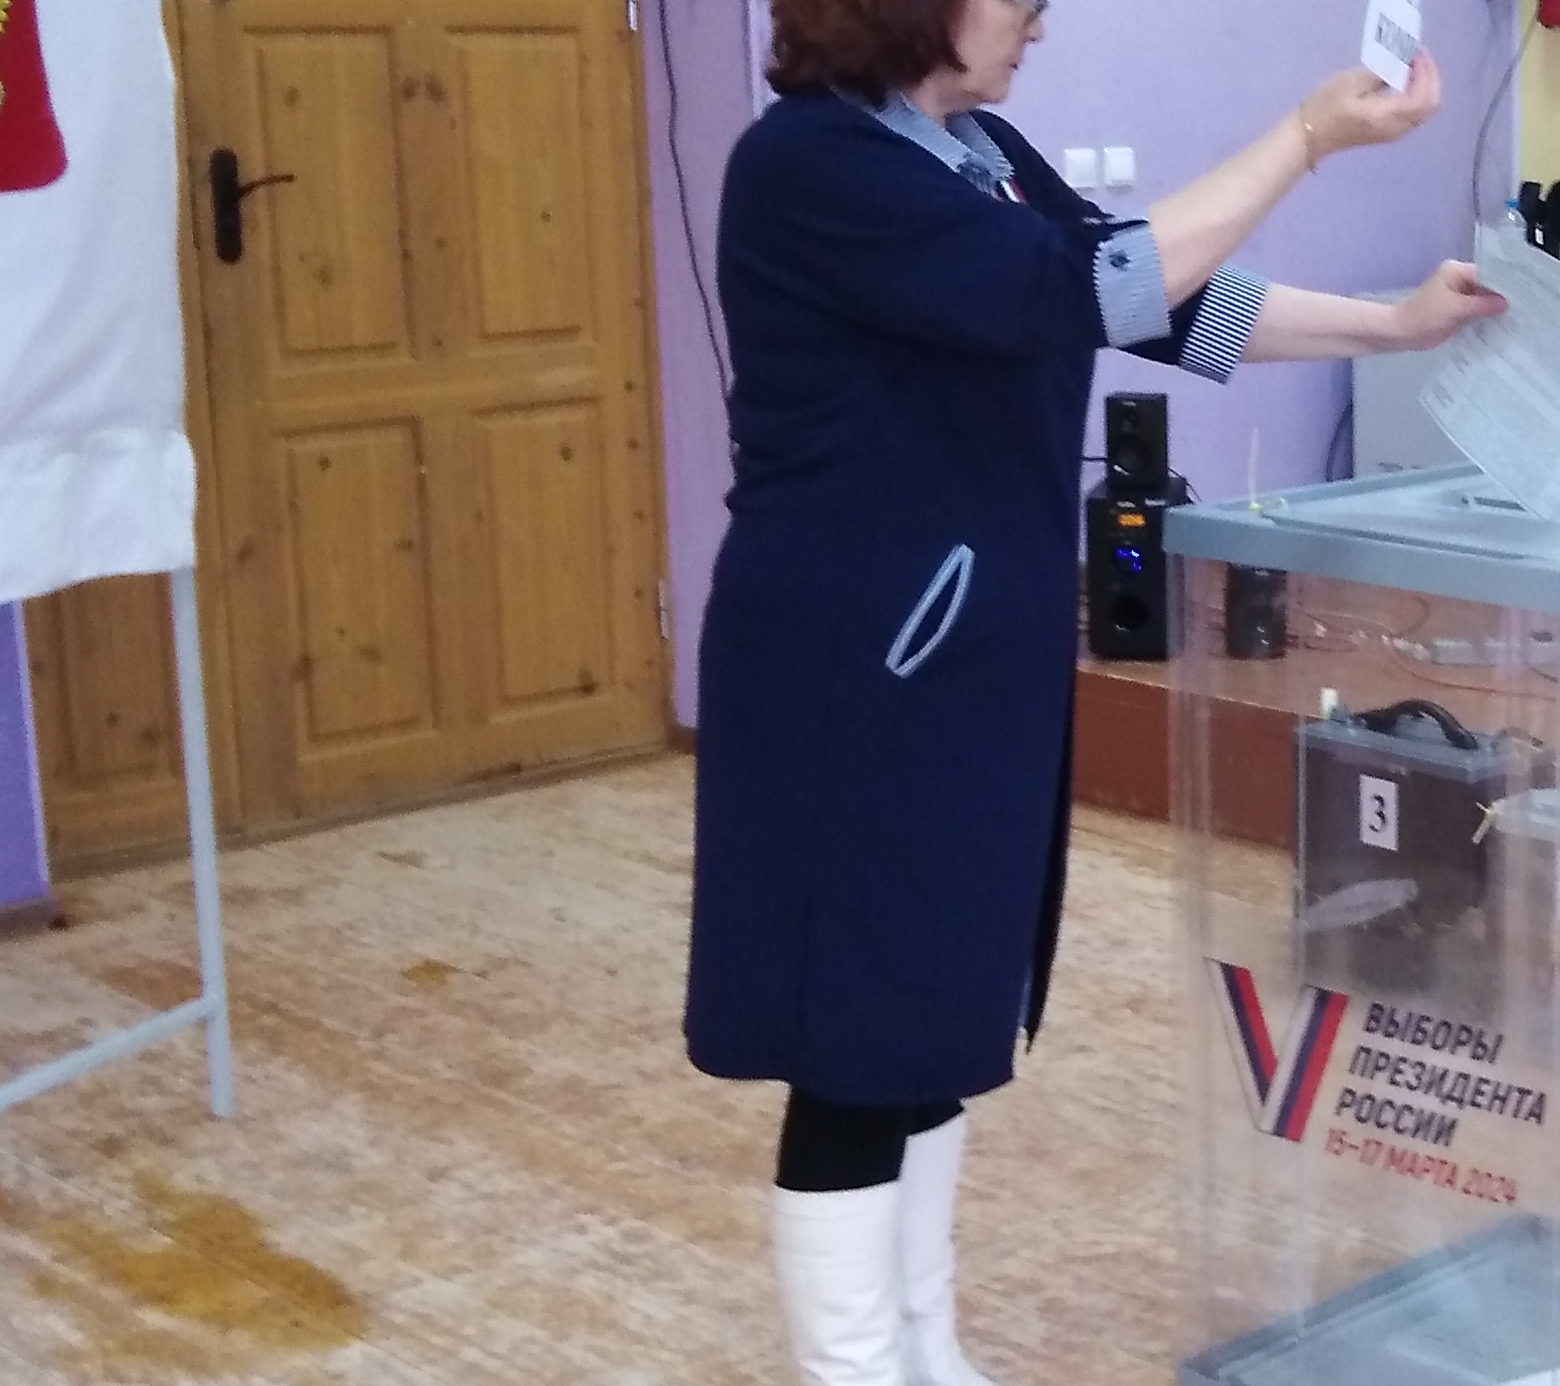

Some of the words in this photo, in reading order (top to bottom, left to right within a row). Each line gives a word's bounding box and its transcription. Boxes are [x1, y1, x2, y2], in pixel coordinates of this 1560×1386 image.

[1367, 794, 1388, 834] 3
[1362, 1001, 1504, 1064] ВЫБОРЫ
[1349, 1044, 1547, 1126] ПРЕЗИДЕНТА
[1335, 1087, 1459, 1148] РОССИИ
[1383, 1146, 1458, 1191] МАРТА
